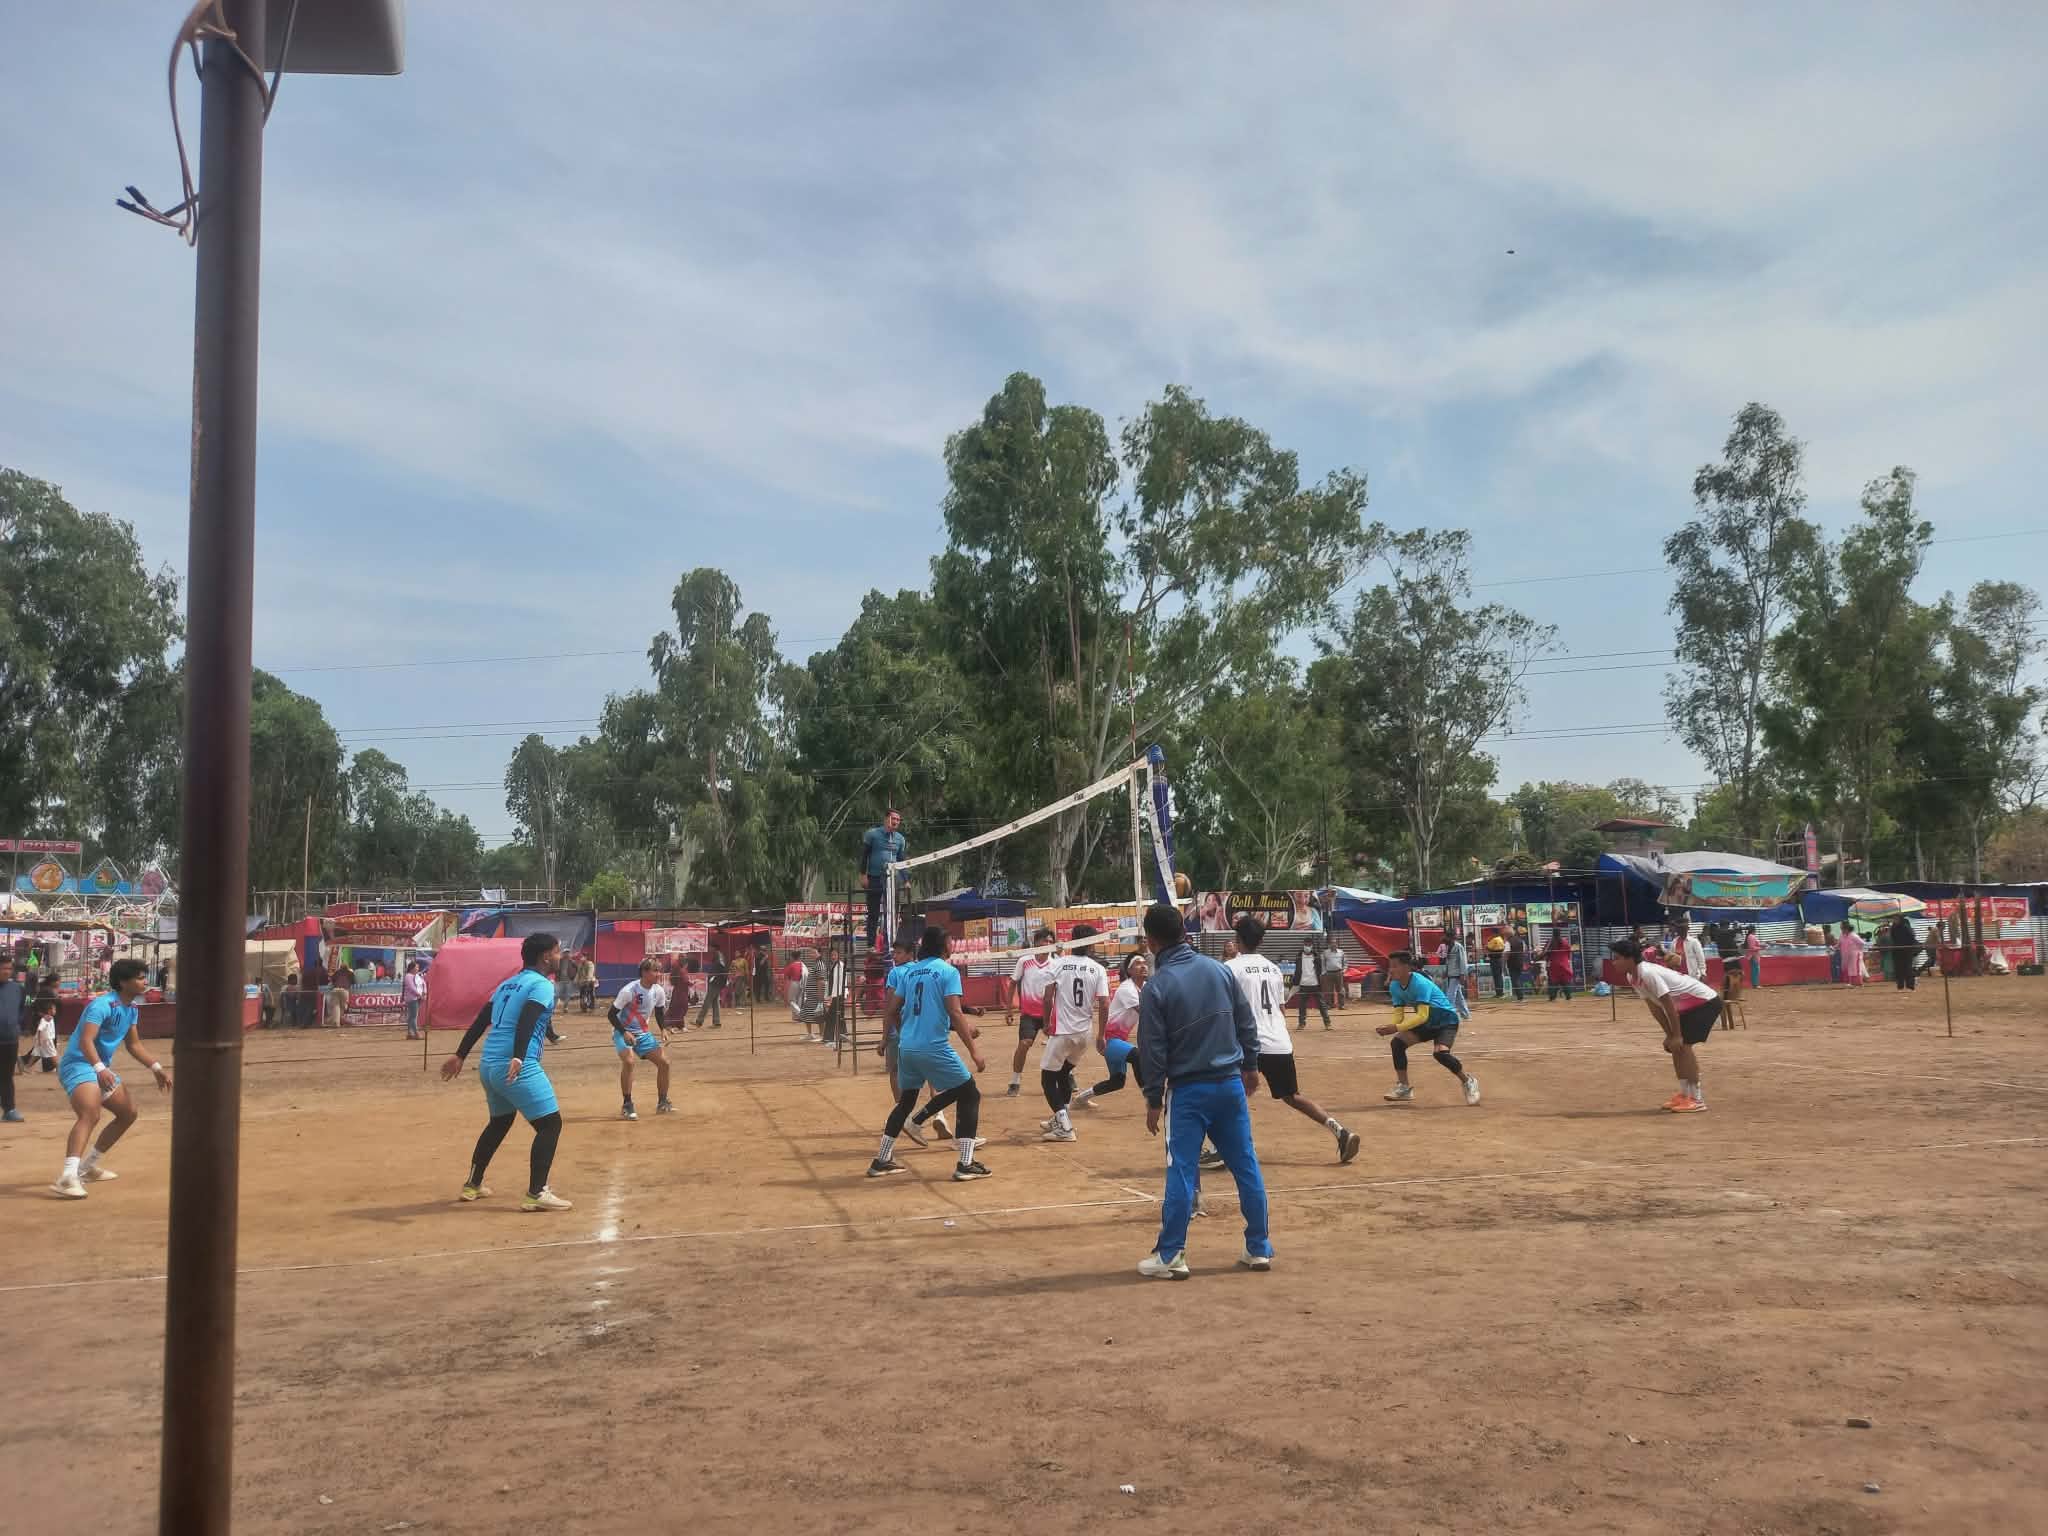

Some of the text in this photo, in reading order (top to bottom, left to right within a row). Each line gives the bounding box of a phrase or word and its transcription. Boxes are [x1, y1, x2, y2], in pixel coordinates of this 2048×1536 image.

[355, 995, 402, 1007] CORN
[1073, 977, 1084, 1007] 6
[1261, 979, 1272, 1015] 4
